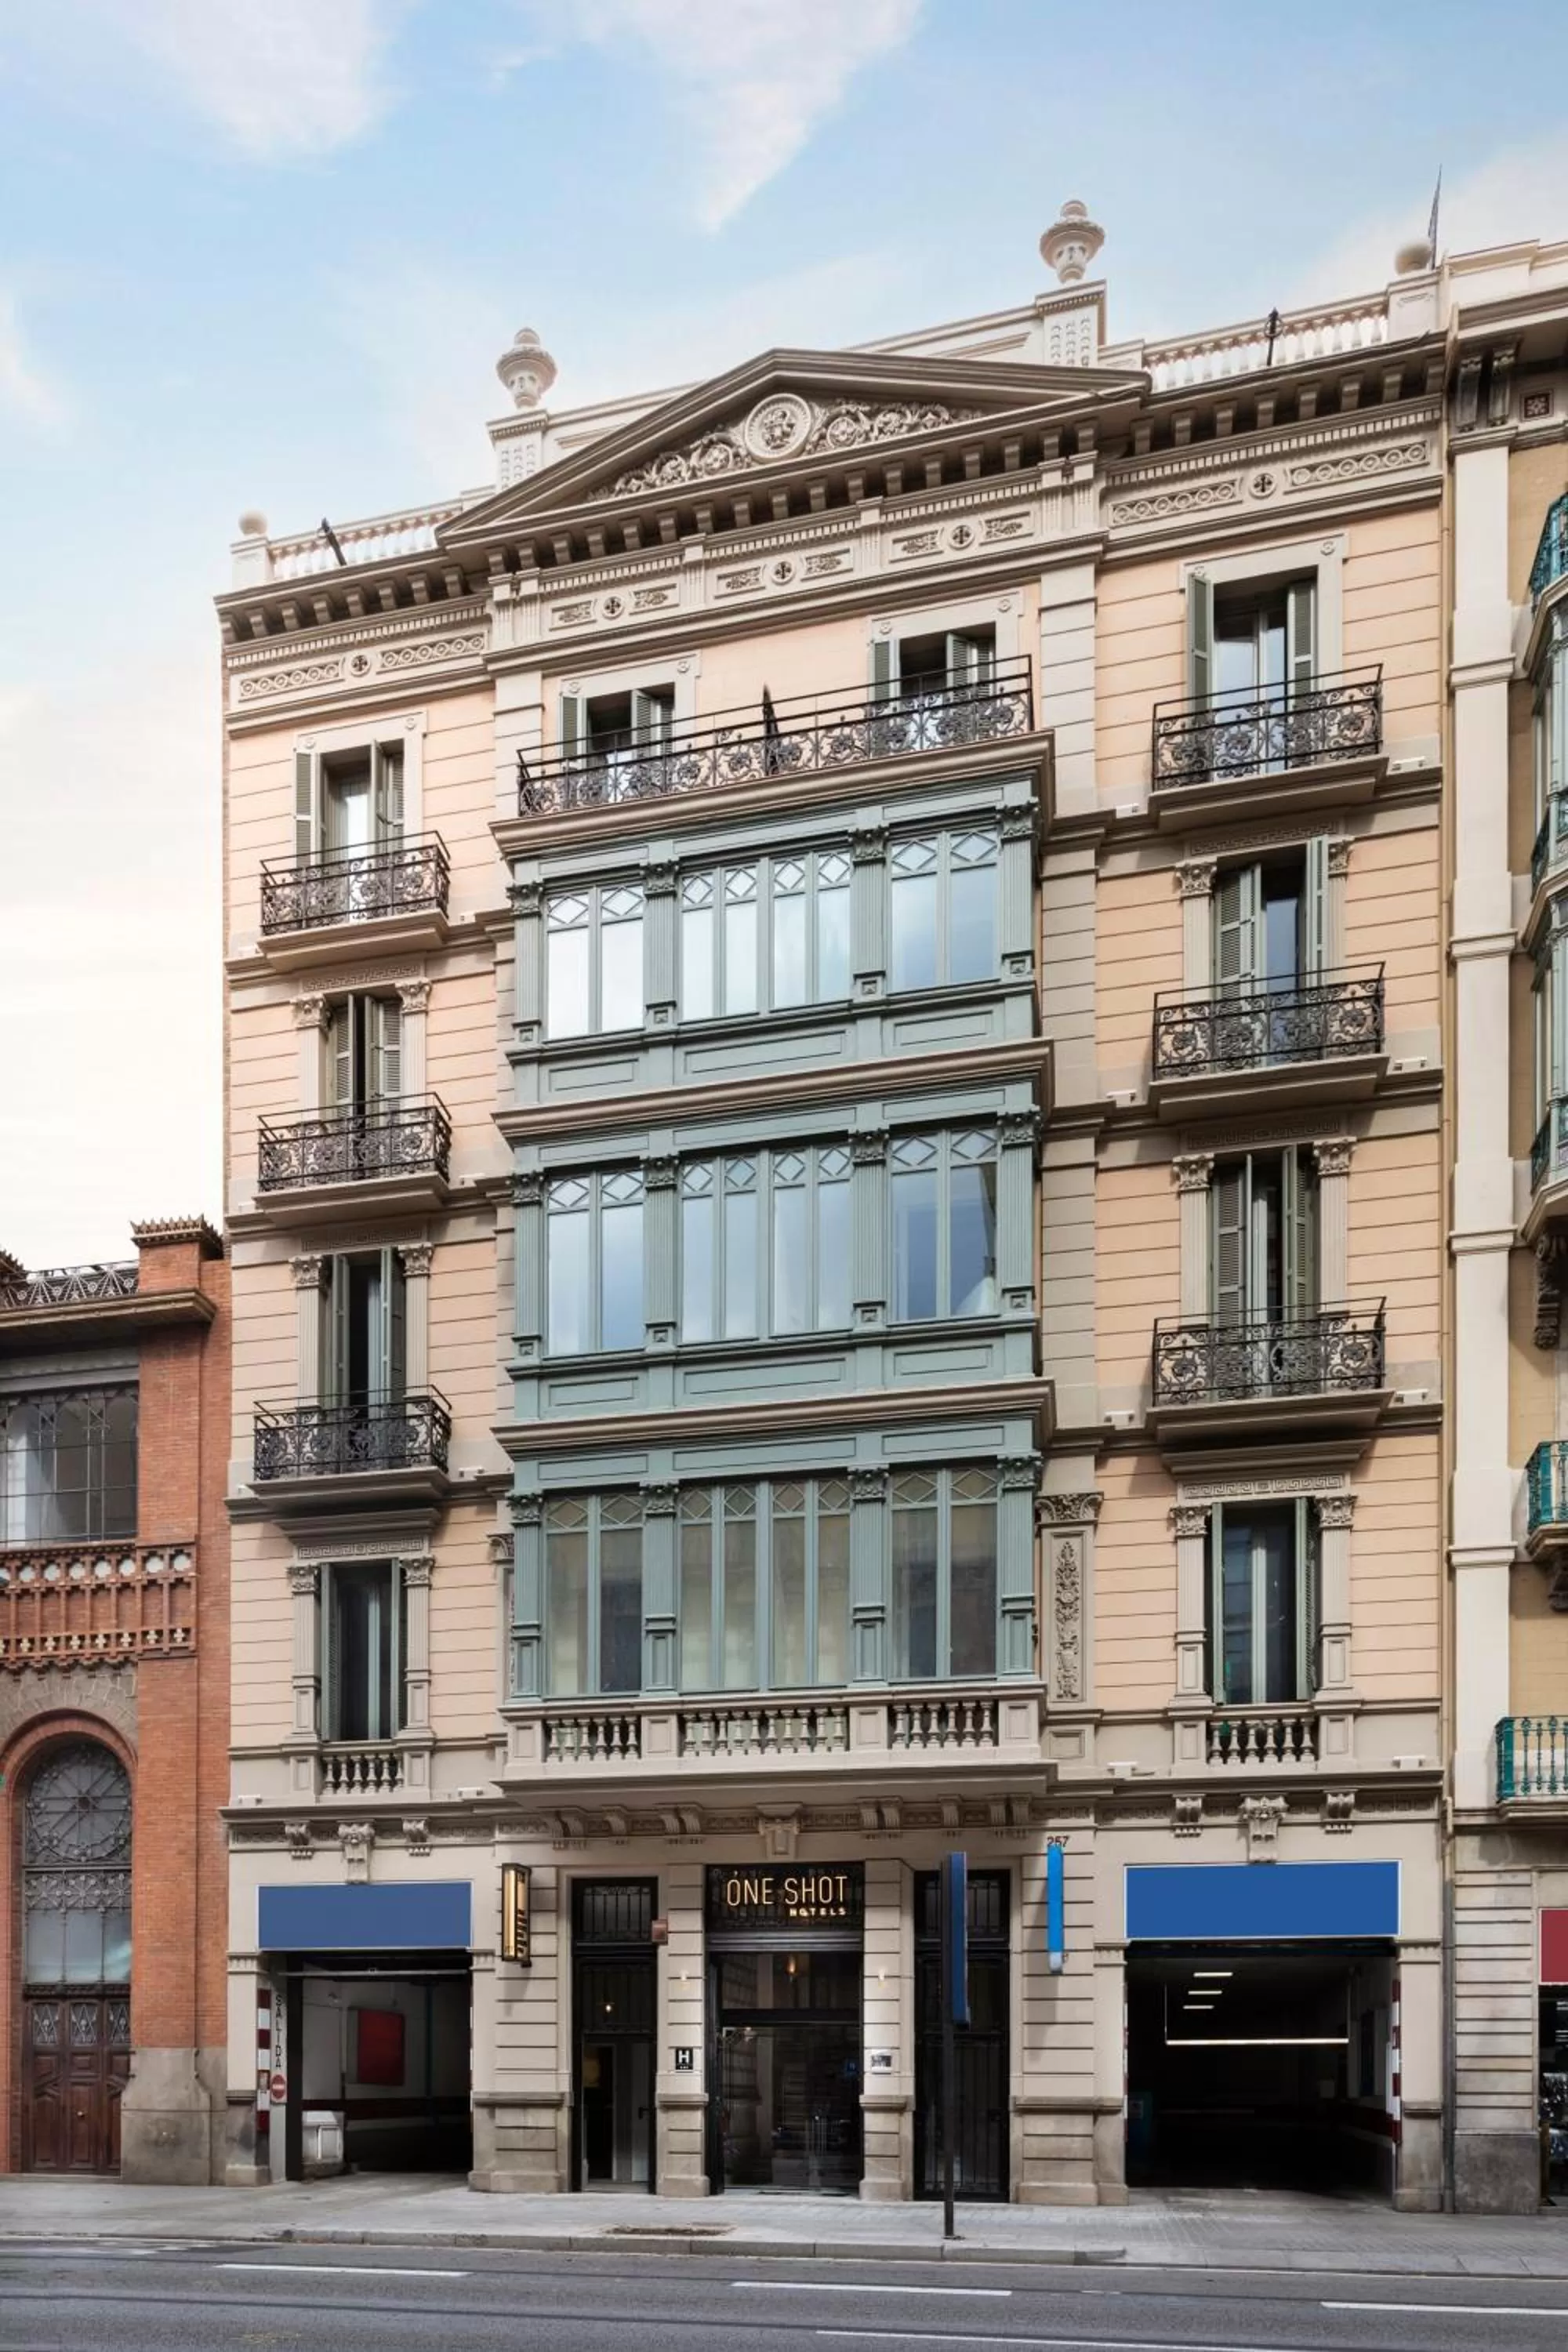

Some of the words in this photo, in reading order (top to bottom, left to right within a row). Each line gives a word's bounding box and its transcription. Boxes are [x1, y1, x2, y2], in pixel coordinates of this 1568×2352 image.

[727, 1878, 775, 1906] ONE
[784, 1876, 848, 1905] SHOT
[789, 1907, 846, 1917] HOTELS
[678, 2050, 690, 2063] H
